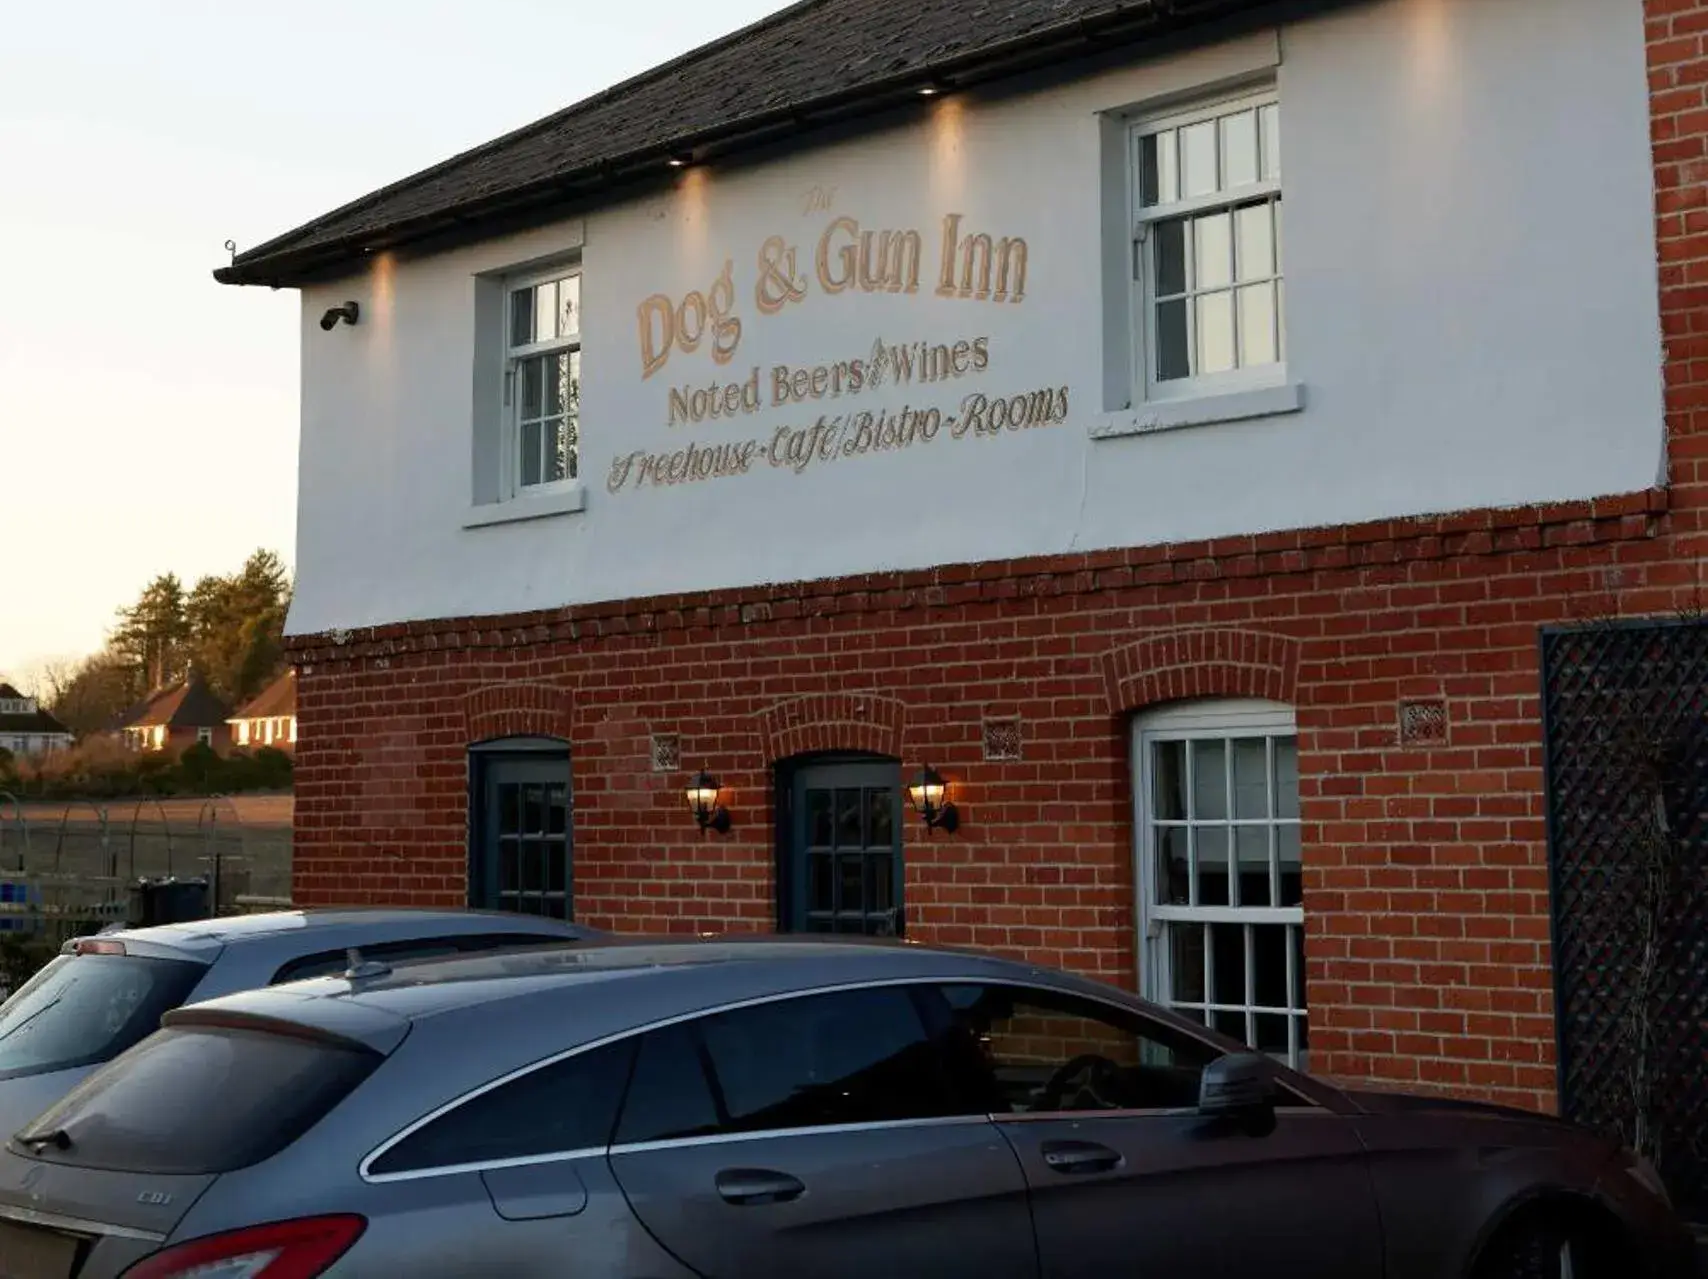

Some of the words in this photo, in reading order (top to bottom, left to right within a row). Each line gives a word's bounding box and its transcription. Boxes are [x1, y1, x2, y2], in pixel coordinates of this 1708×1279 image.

[636, 259, 742, 381] Dog
[754, 234, 808, 315] &
[815, 215, 923, 294] Gun
[935, 212, 1029, 304] Inn
[667, 366, 761, 426] Noted
[770, 355, 864, 408] Beers
[890, 335, 990, 385] Wines
